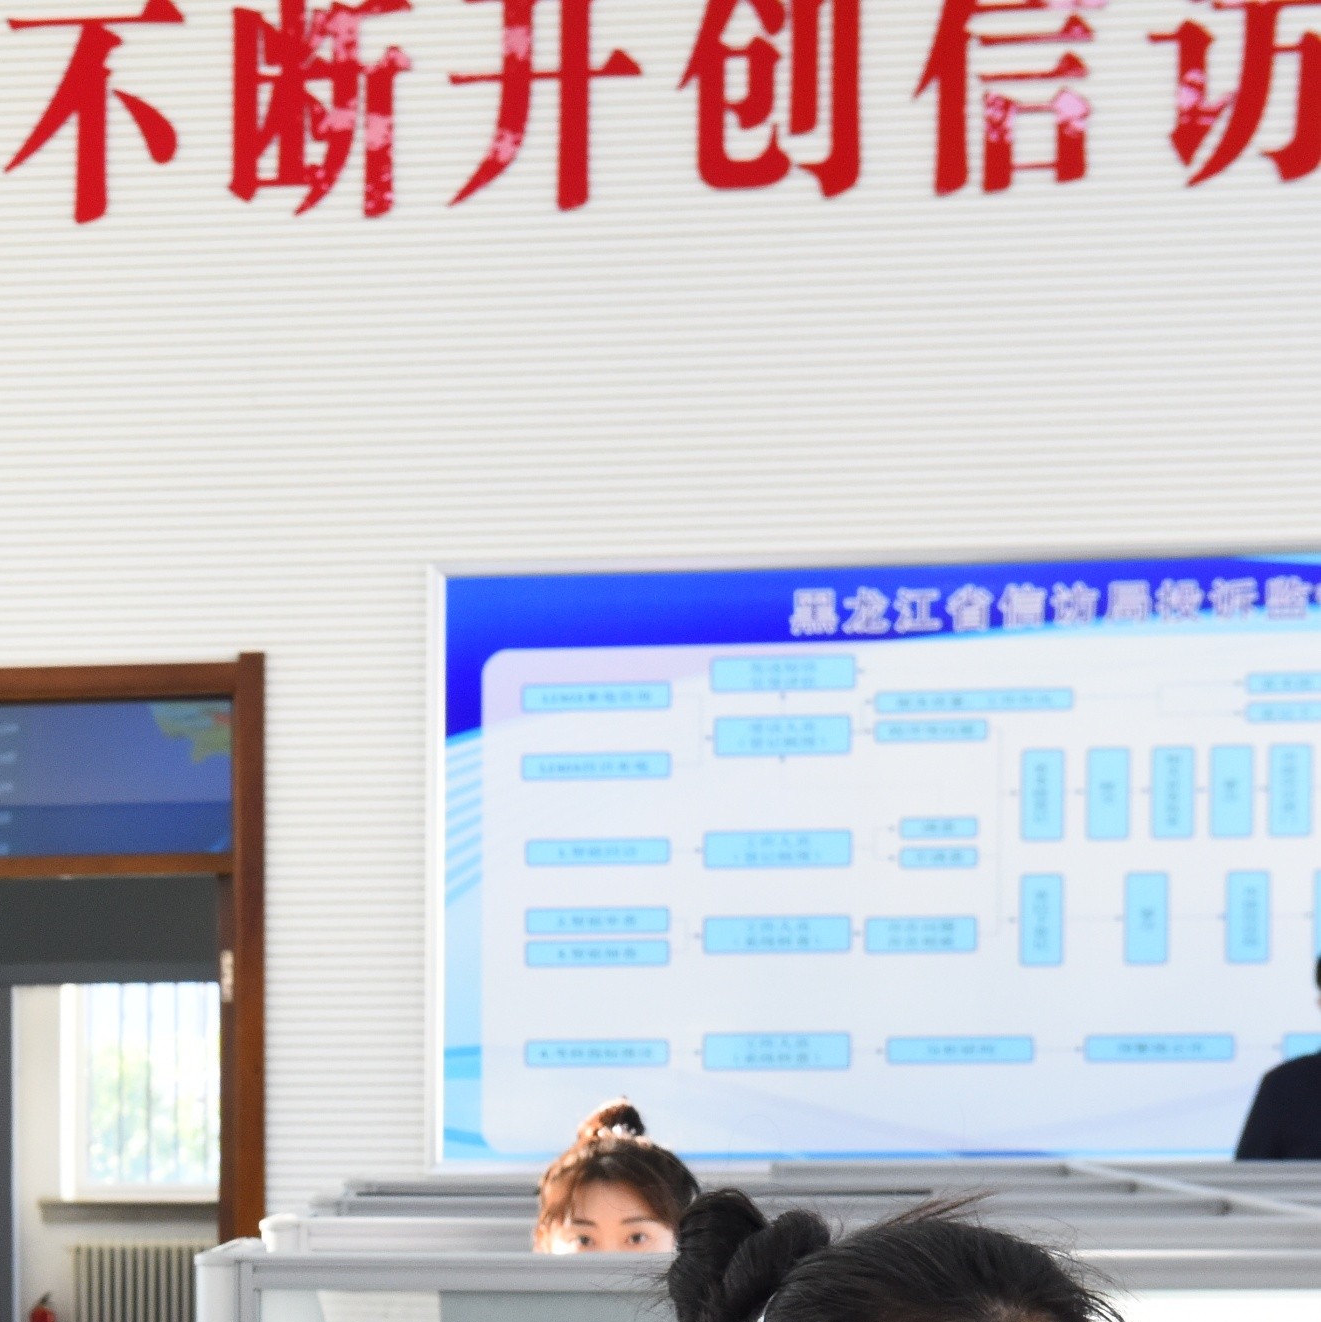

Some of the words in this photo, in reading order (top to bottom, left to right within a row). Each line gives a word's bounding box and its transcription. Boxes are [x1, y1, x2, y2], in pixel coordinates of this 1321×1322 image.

[790, 575, 1321, 636] 黑龙江省信访局投诉监
